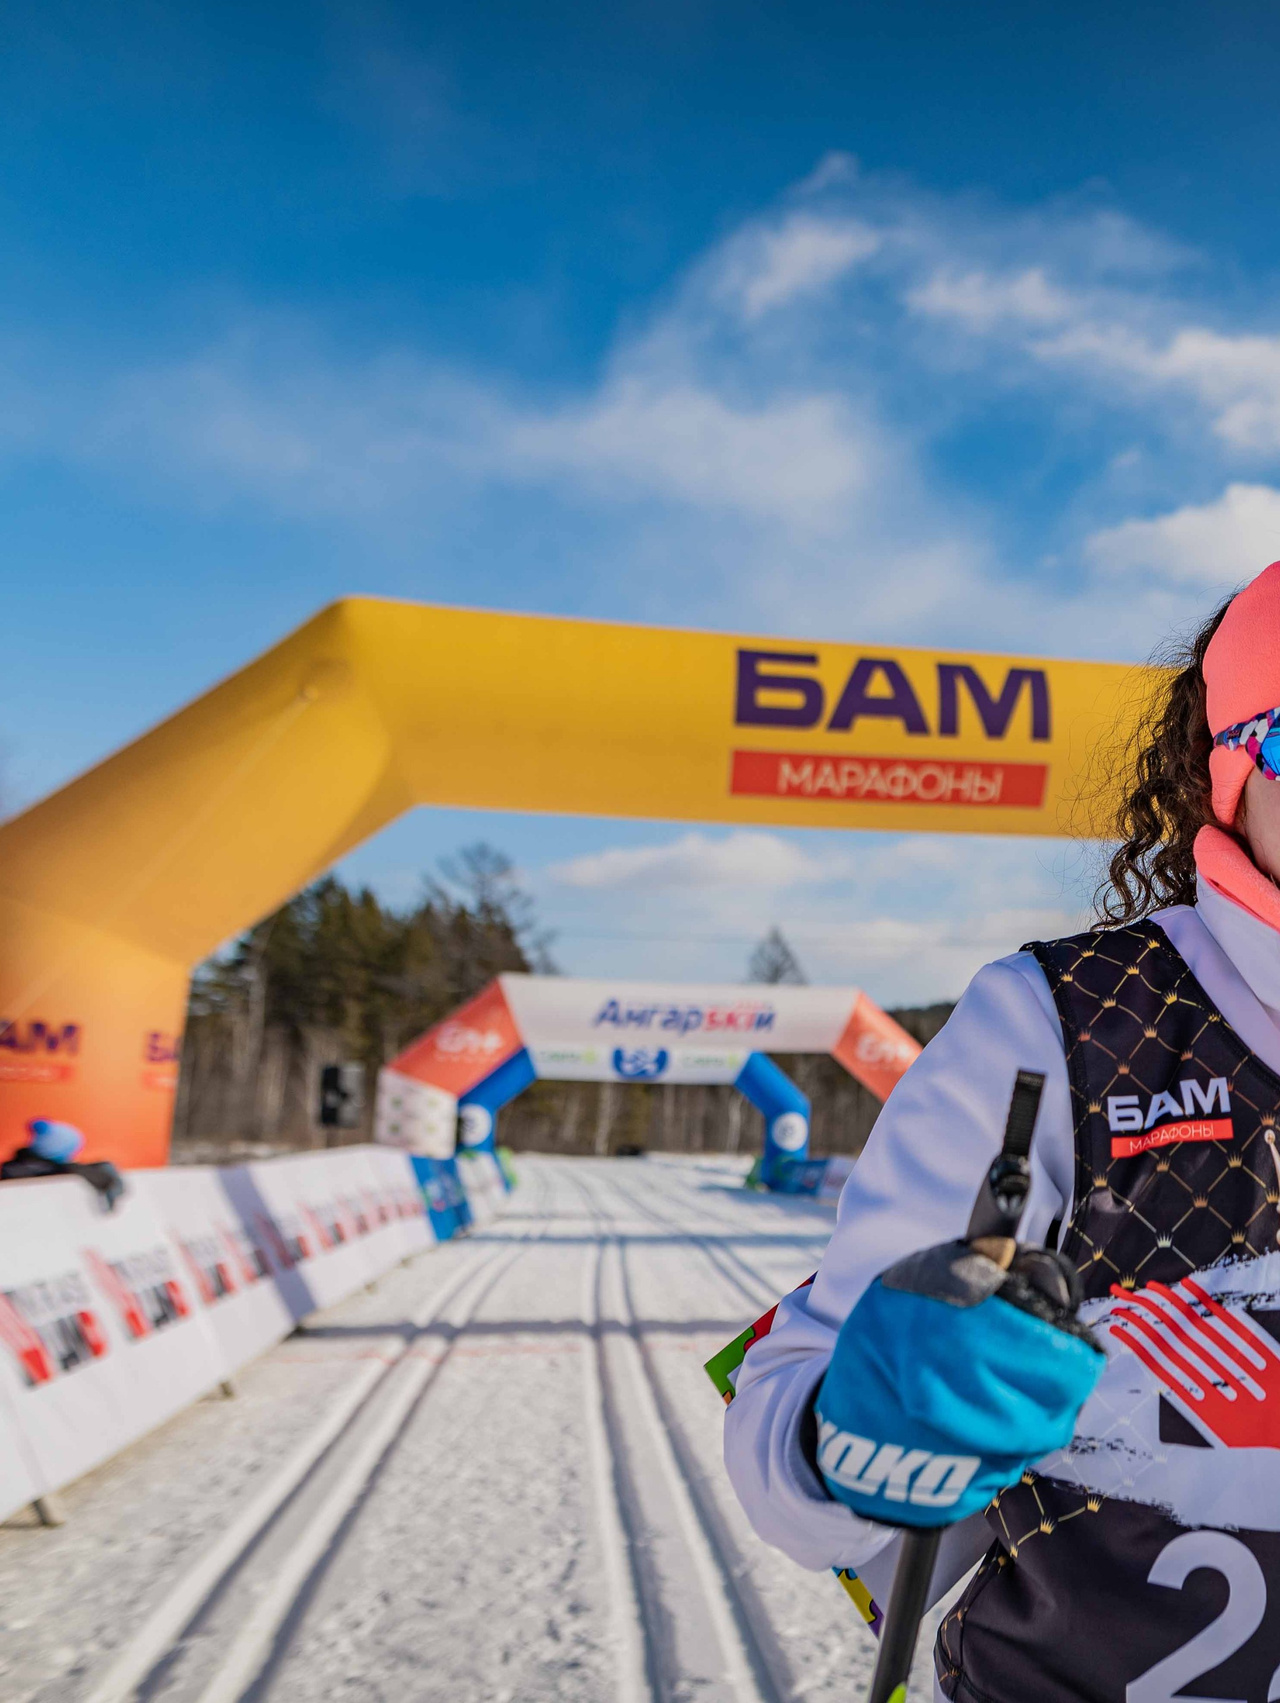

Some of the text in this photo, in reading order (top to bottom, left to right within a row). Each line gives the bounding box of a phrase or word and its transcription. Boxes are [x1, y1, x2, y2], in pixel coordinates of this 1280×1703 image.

[734, 647, 1052, 743] БАМ
[776, 757, 1004, 802] МАРАФОНЫ
[1107, 1076, 1231, 1132] БАМ
[1129, 1123, 1215, 1154] МАРАФОНЫ
